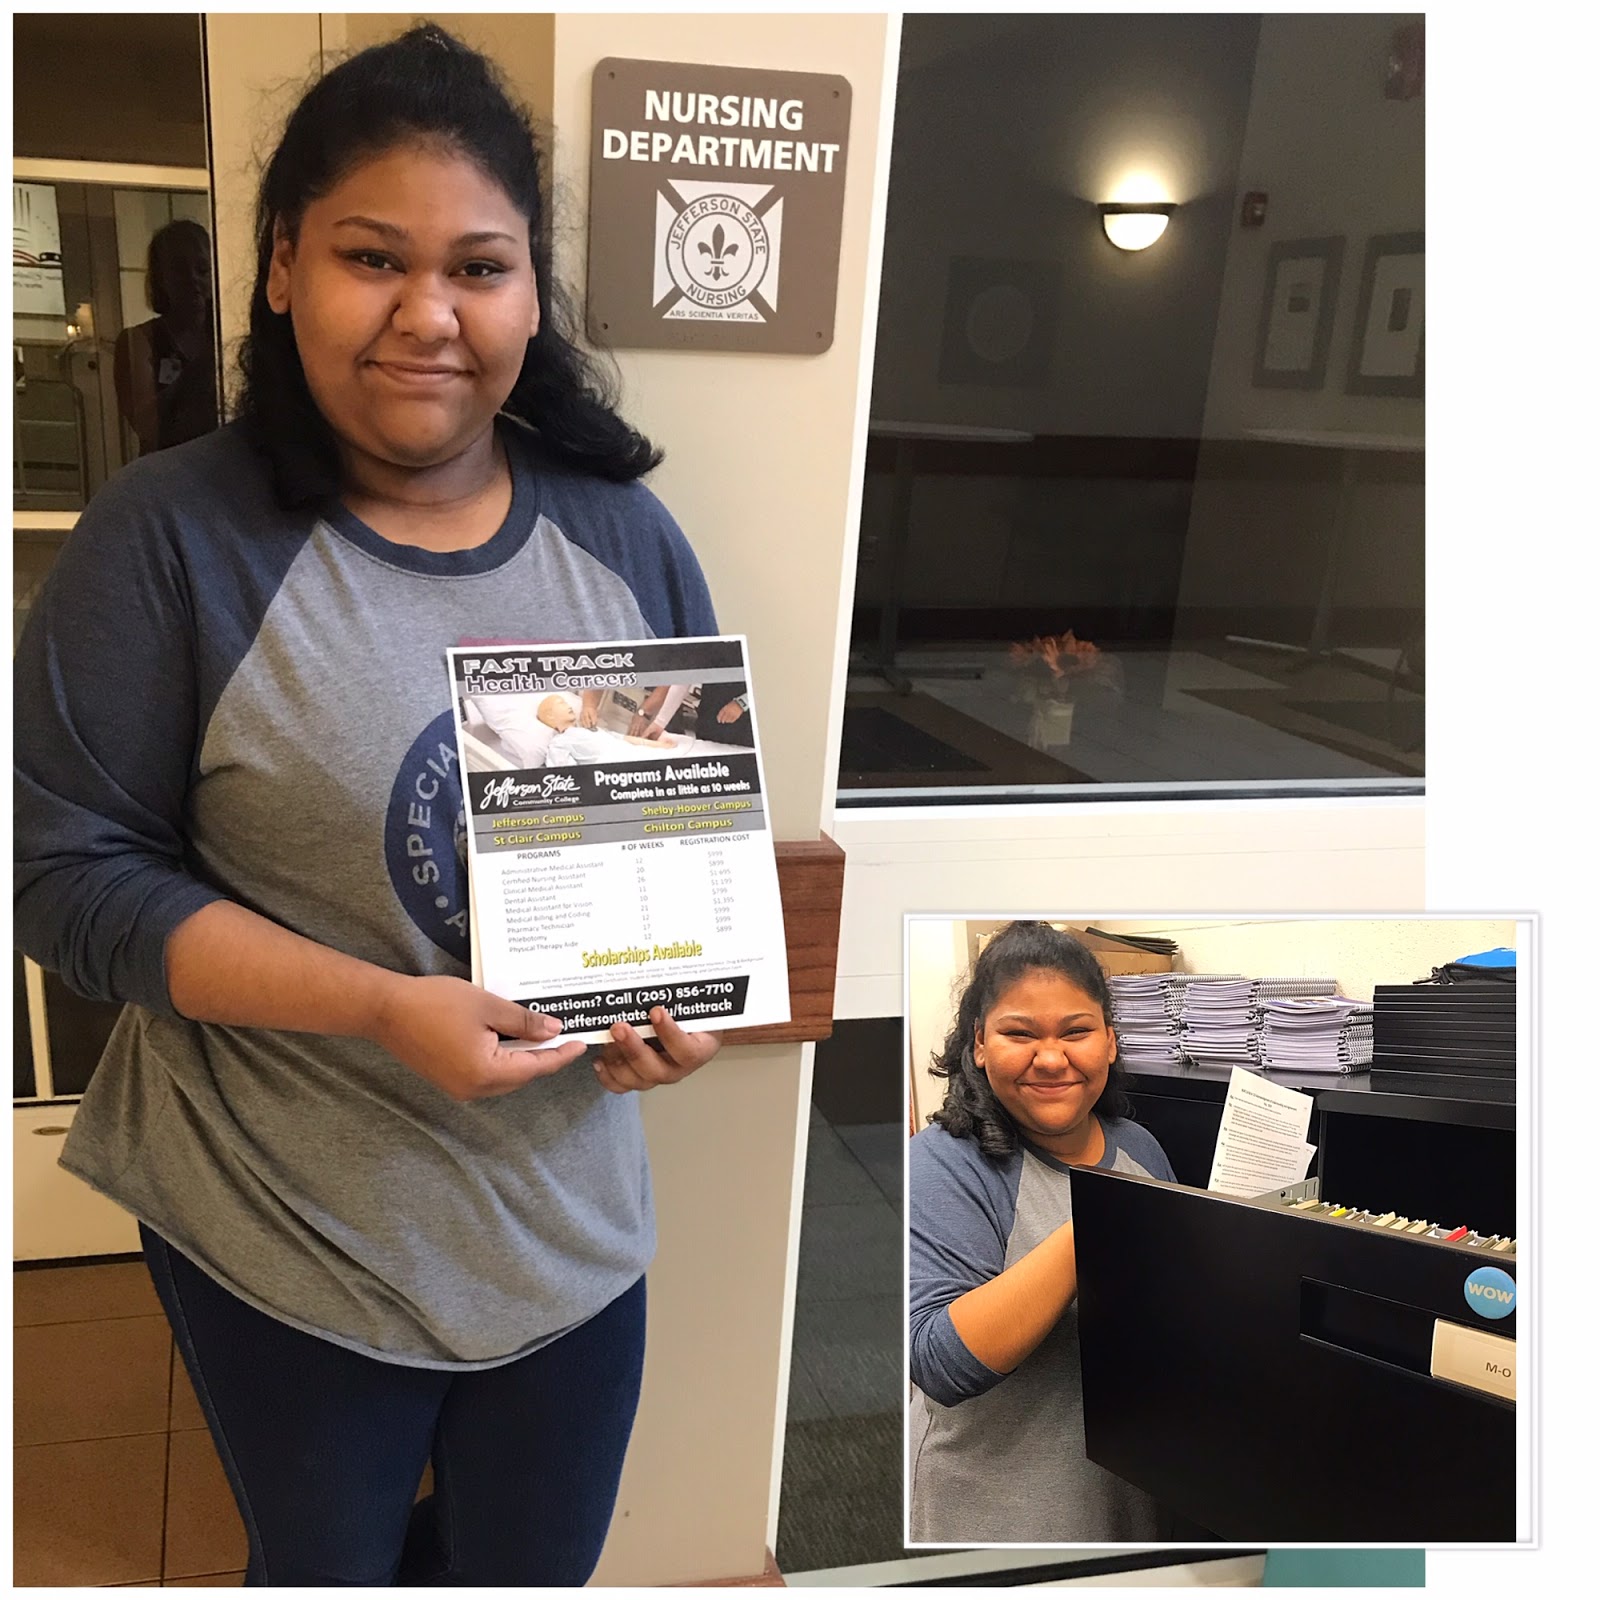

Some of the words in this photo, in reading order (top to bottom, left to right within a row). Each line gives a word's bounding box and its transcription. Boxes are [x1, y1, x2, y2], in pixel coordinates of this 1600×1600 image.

[645, 89, 804, 131] NURSING
[602, 128, 840, 173] DEPARTMENT
[671, 199, 740, 250] JEFFERSON
[741, 212, 766, 255] STATE
[686, 283, 747, 306] NURSING
[669, 310, 686, 318] ARS
[689, 311, 724, 319] SCIENTIA
[726, 312, 760, 321] VERITAS
[462, 657, 532, 675] FAST
[537, 652, 635, 672] TRACK
[465, 673, 546, 694] Health
[551, 671, 637, 690] Careers
[593, 768, 662, 788] Programs
[664, 761, 730, 782] Available
[480, 776, 542, 810] Jefferson
[541, 774, 581, 798] State
[610, 787, 654, 801] Complete
[655, 786, 665, 797] in
[666, 787, 677, 797] as
[677, 784, 700, 796] little
[700, 784, 711, 794] as
[711, 782, 723, 793] 10
[723, 780, 751, 792] weeks
[405, 731, 459, 886] SPECIA
[512, 798, 553, 807] Community
[554, 796, 580, 804] College
[641, 803, 712, 817] Shelby-Hoover
[713, 800, 753, 811] Campus
[492, 815, 540, 829] Jefferson
[542, 812, 585, 826] Campus
[643, 821, 685, 834] Chilton
[687, 818, 734, 830] Campus
[493, 835, 506, 846] St
[508, 834, 534, 845] Clair
[536, 831, 582, 843] Campus
[627, 843, 638, 851] OF
[639, 841, 665, 850] WEEKS
[680, 835, 731, 846] REGISTRATION
[732, 833, 751, 843] COST
[517, 850, 562, 860] PROGRAMS
[549, 863, 575, 872] Medical
[531, 875, 557, 884] Nursing
[528, 884, 554, 893] Medical
[504, 896, 527, 905] Dental
[581, 945, 652, 969] Scholarships
[652, 939, 703, 961] Available
[528, 994, 602, 1014] Questions?
[605, 992, 633, 1006] Call
[636, 987, 673, 1006] (205)
[675, 982, 734, 998] 856-7710
[1467, 1282, 1515, 1304] WOW
[1485, 1362, 1512, 1378] M-O
